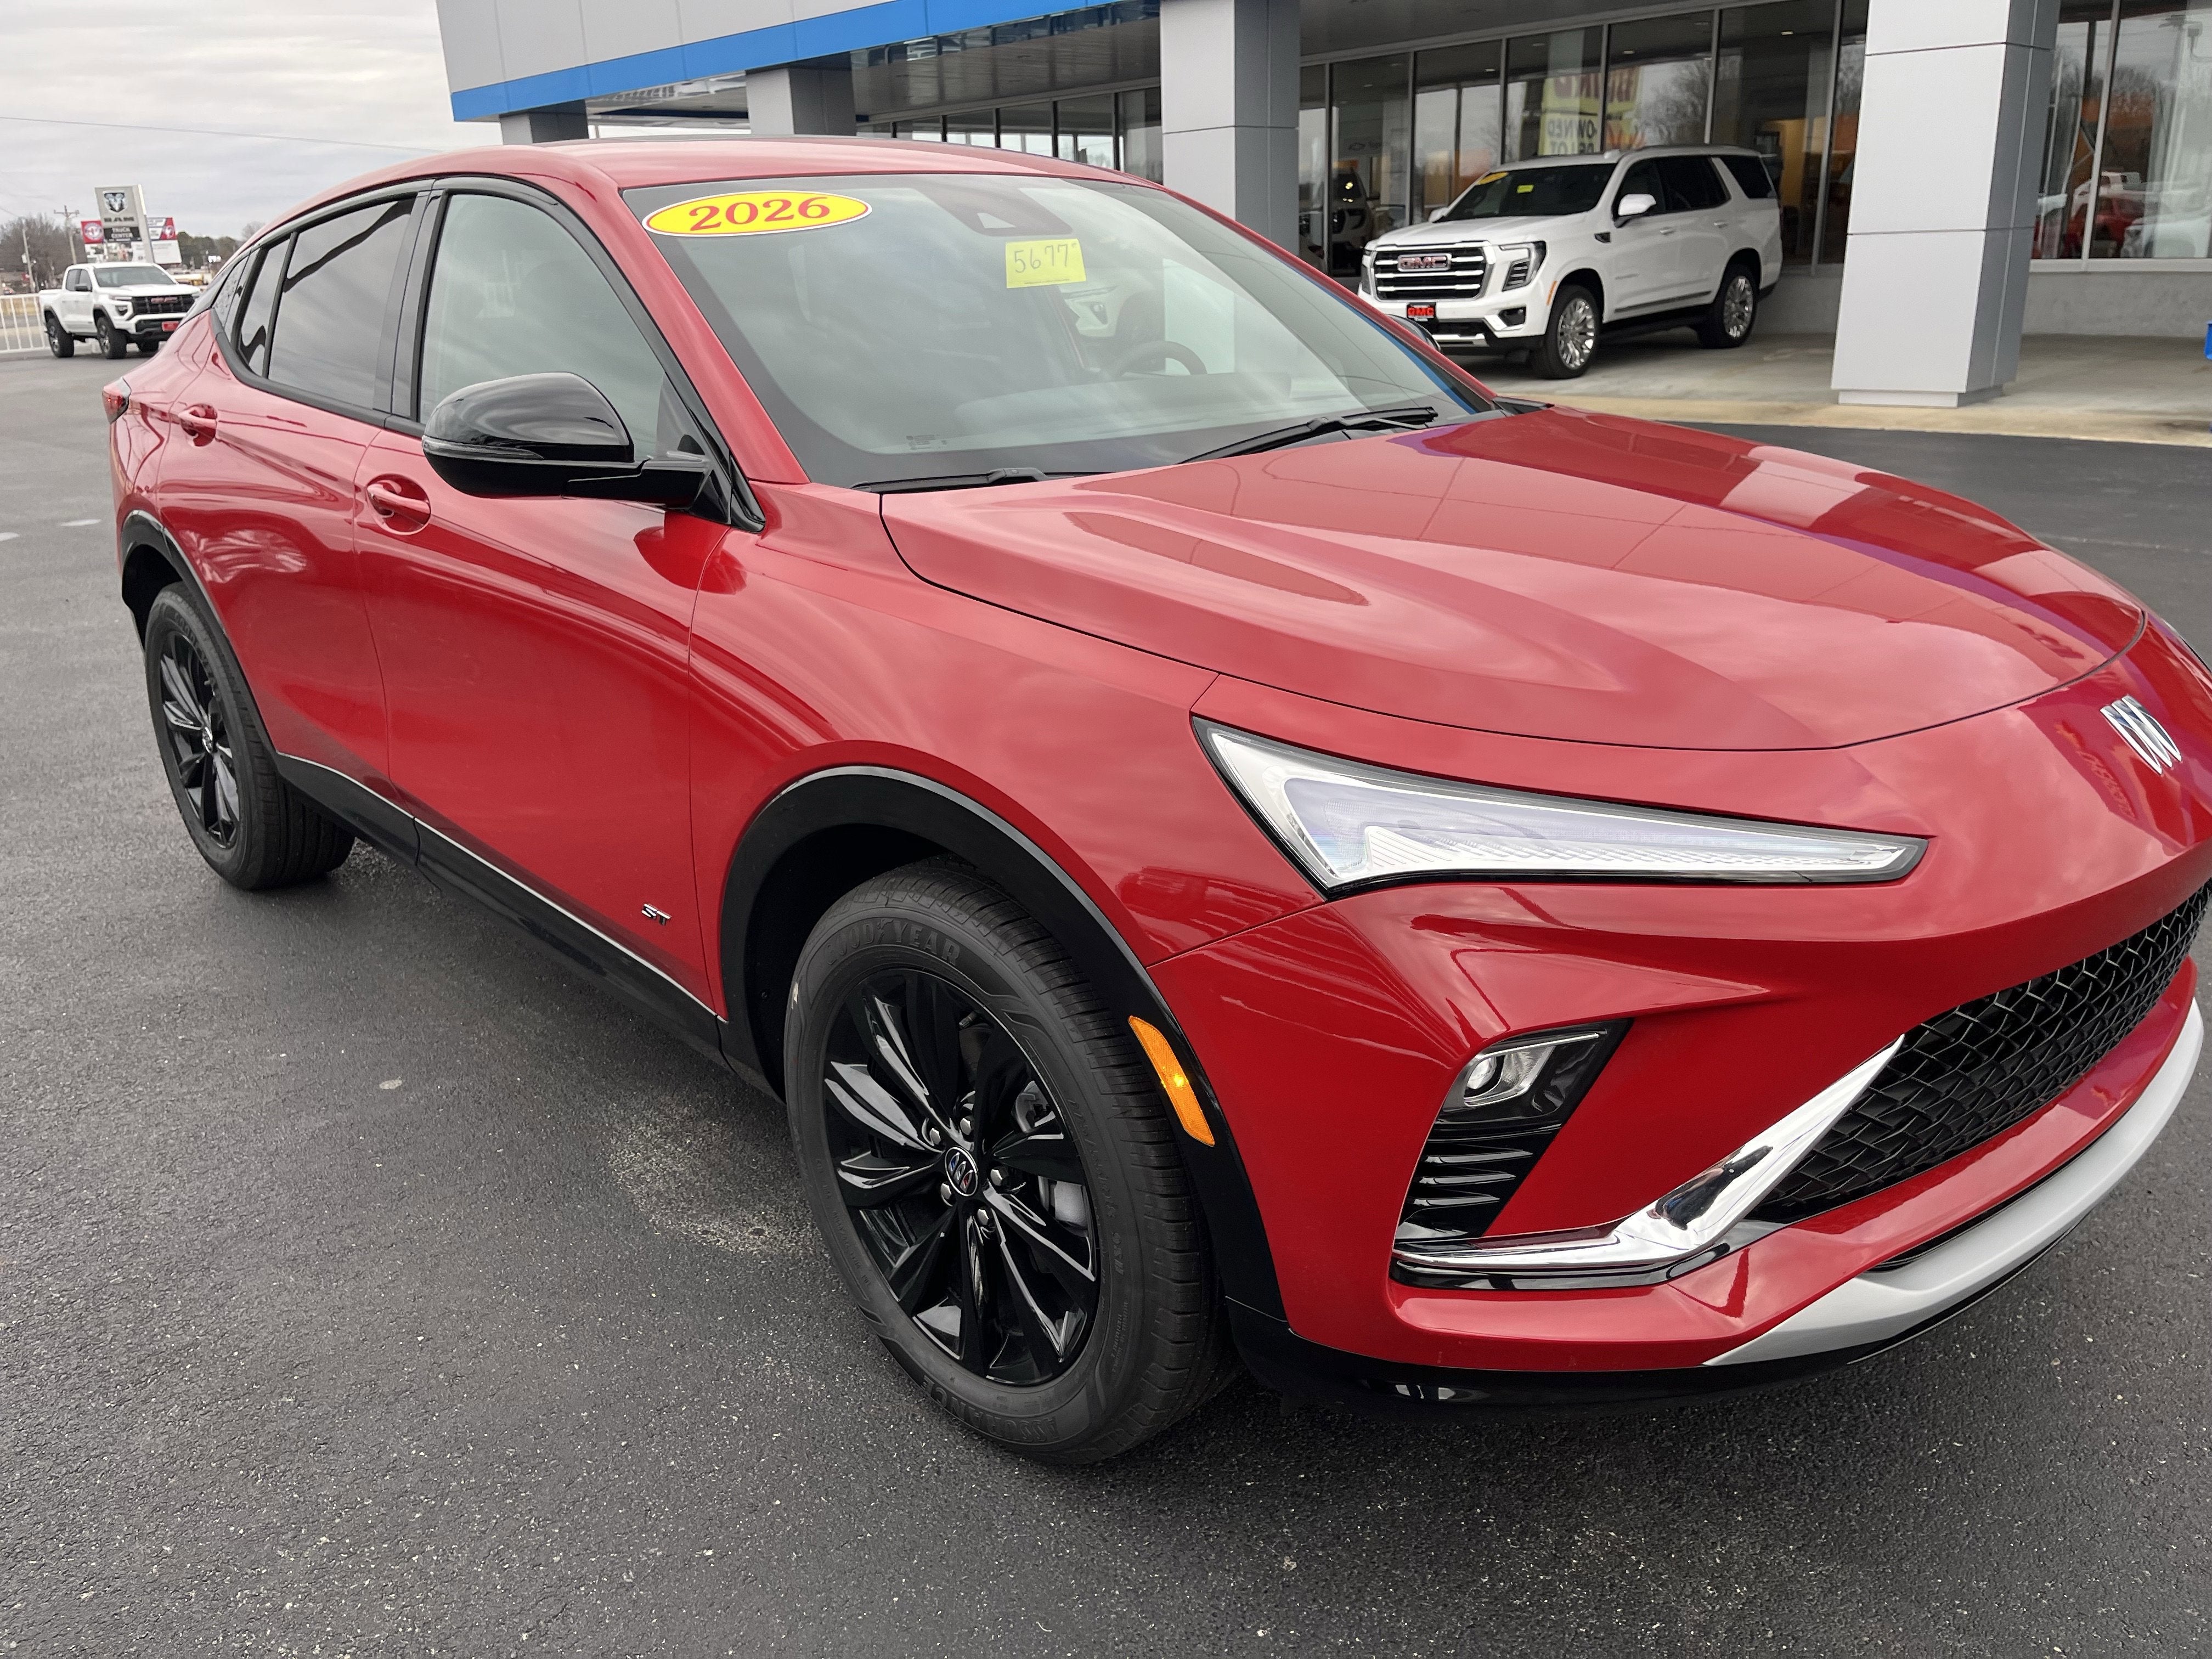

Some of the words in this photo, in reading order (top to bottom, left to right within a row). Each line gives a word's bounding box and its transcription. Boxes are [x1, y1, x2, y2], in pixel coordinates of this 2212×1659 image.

[690, 197, 831, 232] 2026
[1014, 244, 1069, 273] 5677
[1401, 255, 1447, 269] GMC
[1408, 306, 1434, 317] GMC
[641, 903, 673, 926] ST
[921, 1375, 1059, 1442] ASSURANCE
